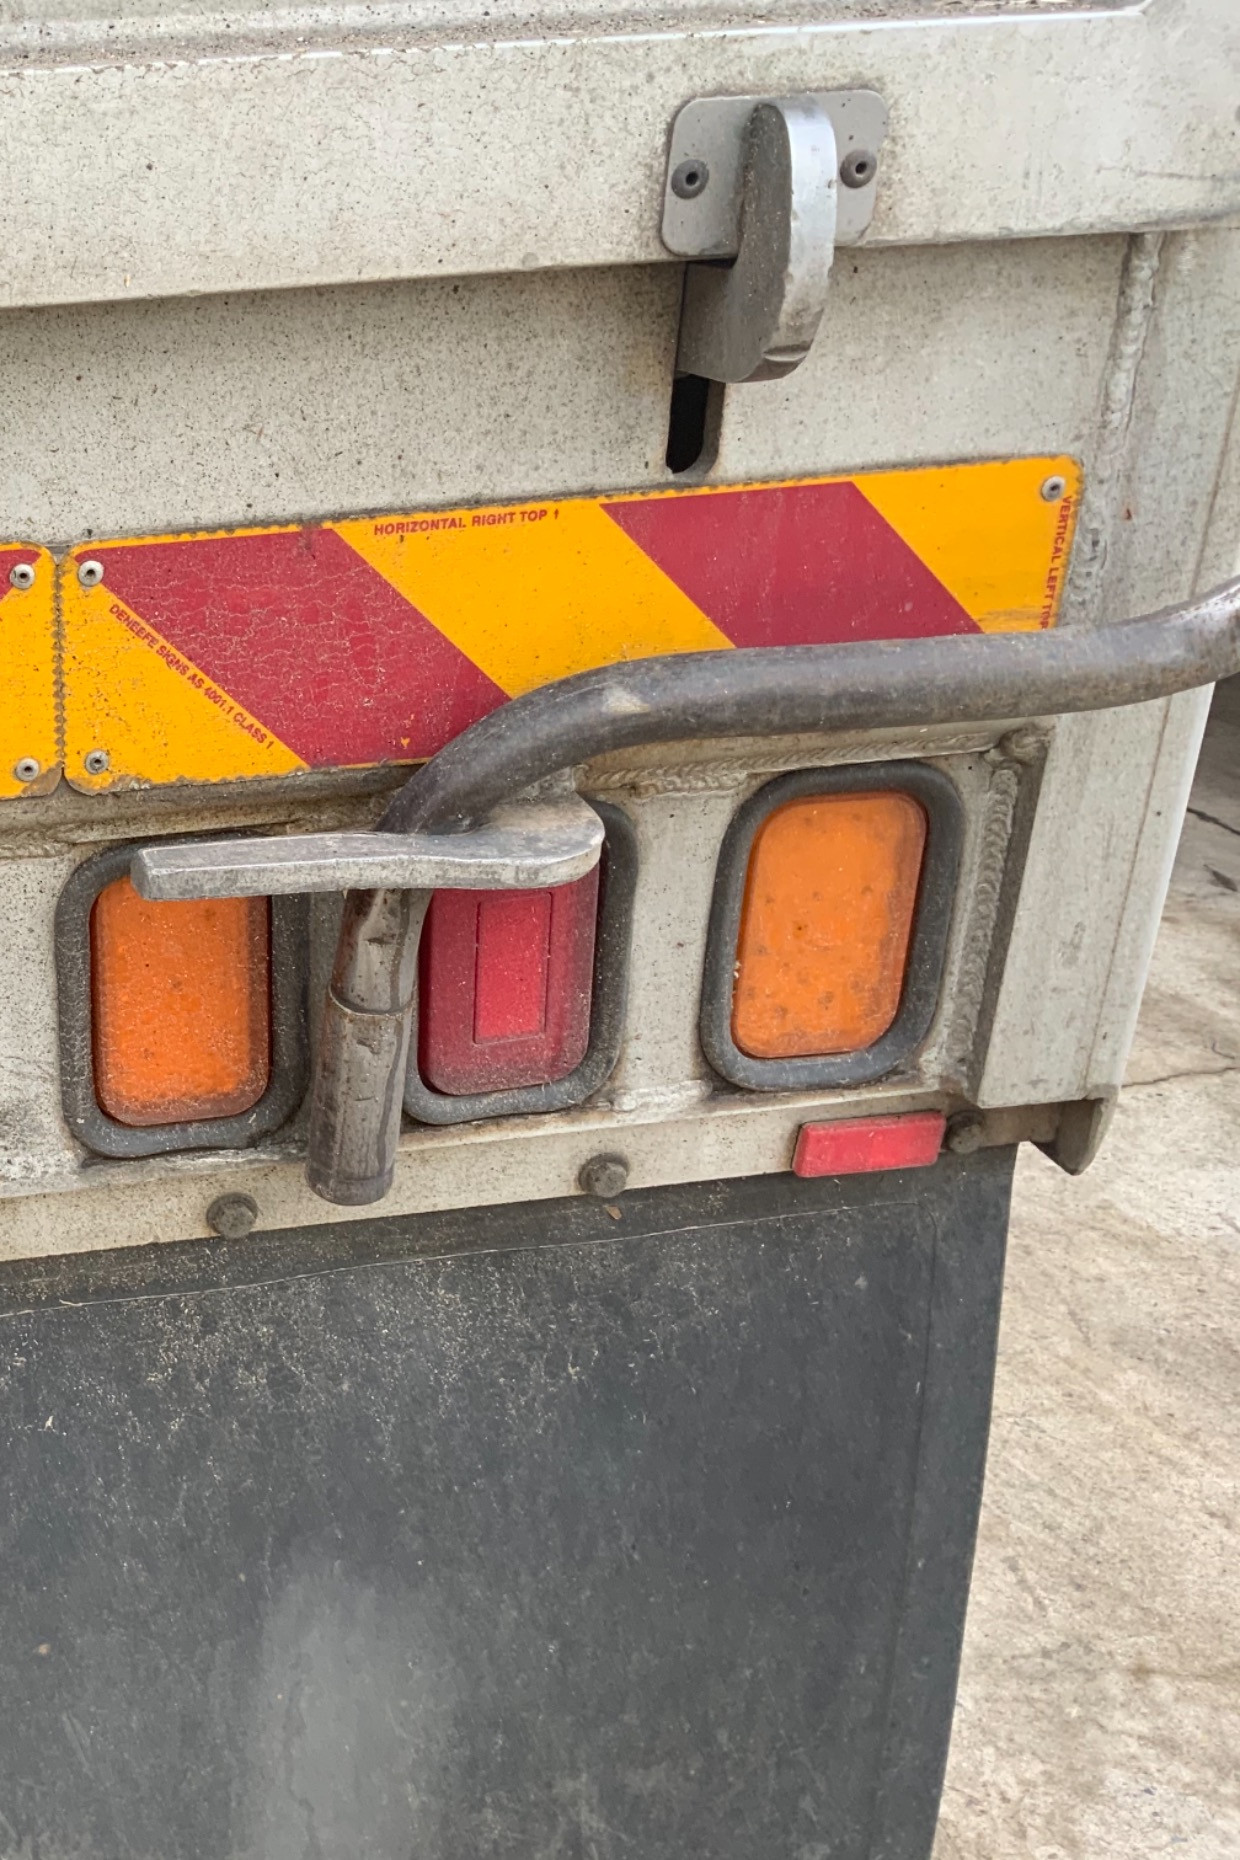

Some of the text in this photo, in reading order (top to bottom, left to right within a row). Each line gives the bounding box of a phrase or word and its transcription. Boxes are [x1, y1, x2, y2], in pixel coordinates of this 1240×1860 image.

[374, 509, 547, 535] HORIZONTAL RIGHT TOP
[1040, 496, 1072, 630] VERTICAL LEFT TOP
[109, 603, 275, 750] DENEEFE SIGNS AS 4001.1 CLASS 1
